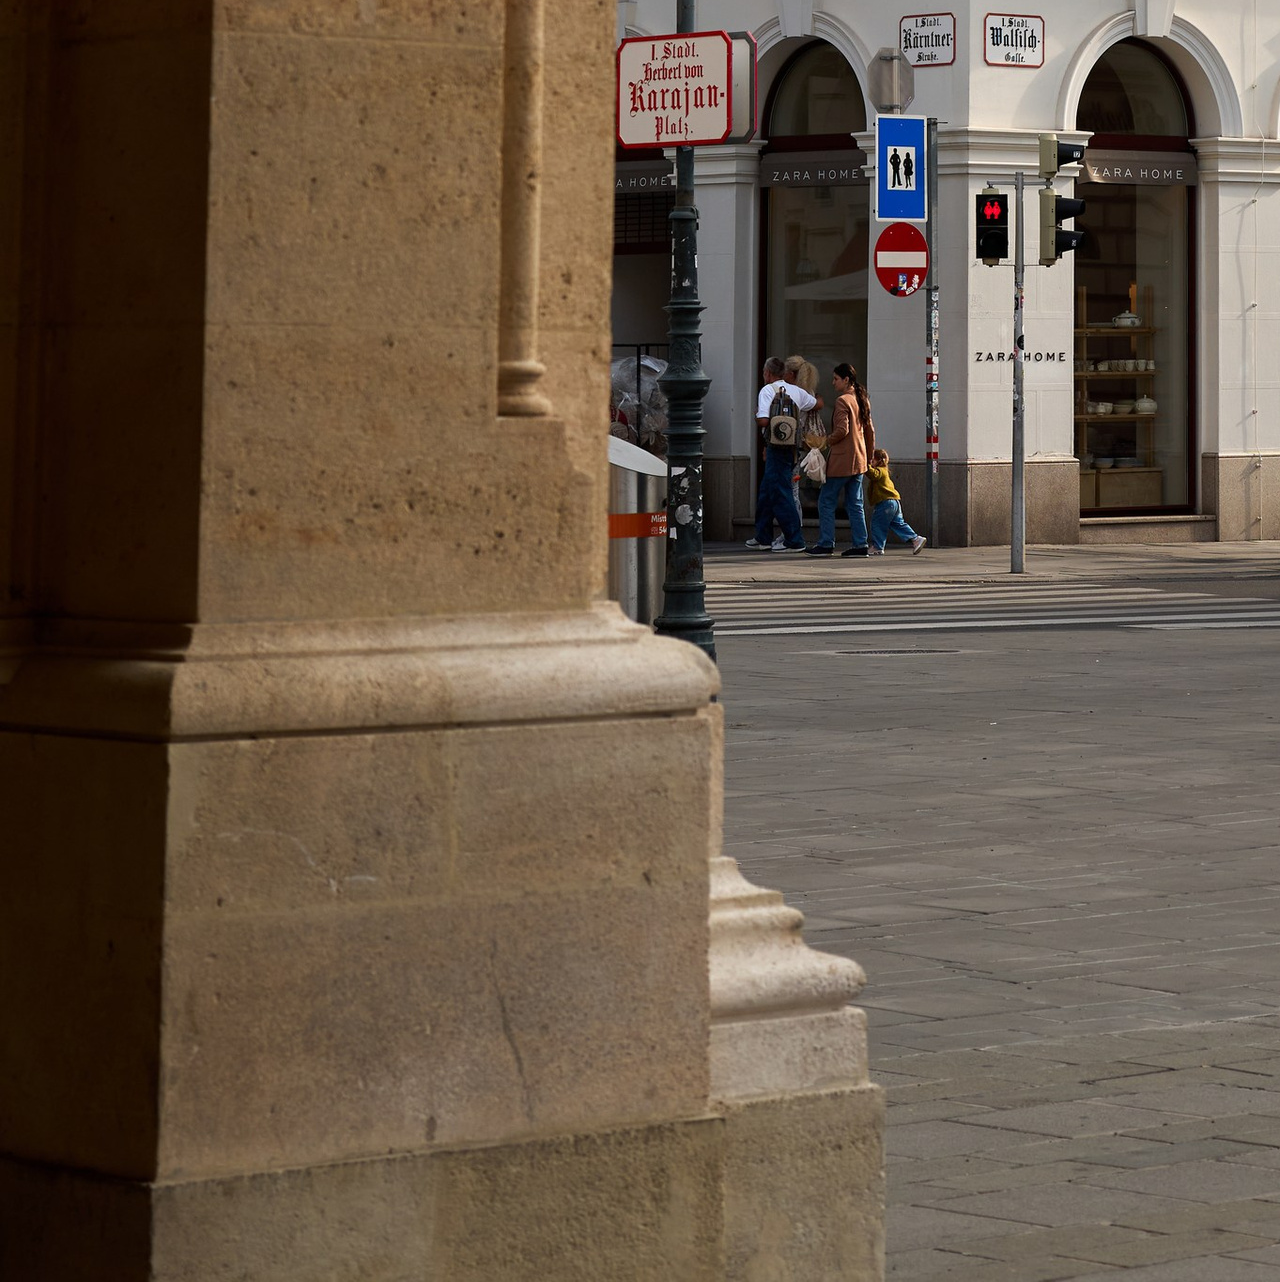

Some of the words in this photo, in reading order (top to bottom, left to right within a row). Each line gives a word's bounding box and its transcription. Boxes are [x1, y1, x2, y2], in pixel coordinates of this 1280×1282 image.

[661, 41, 699, 61] Stadt.
[642, 61, 682, 86] Herbert
[684, 64, 704, 79] von
[628, 79, 725, 118] Karajan-
[655, 115, 694, 141] Platz.
[629, 176, 668, 187] HOME
[772, 170, 811, 181] ZARA
[818, 168, 859, 180] HOME
[1092, 166, 1133, 178] ZARA
[1140, 168, 1183, 180] HOME
[975, 352, 1015, 362] ZARA
[1023, 352, 1066, 362] HOME
